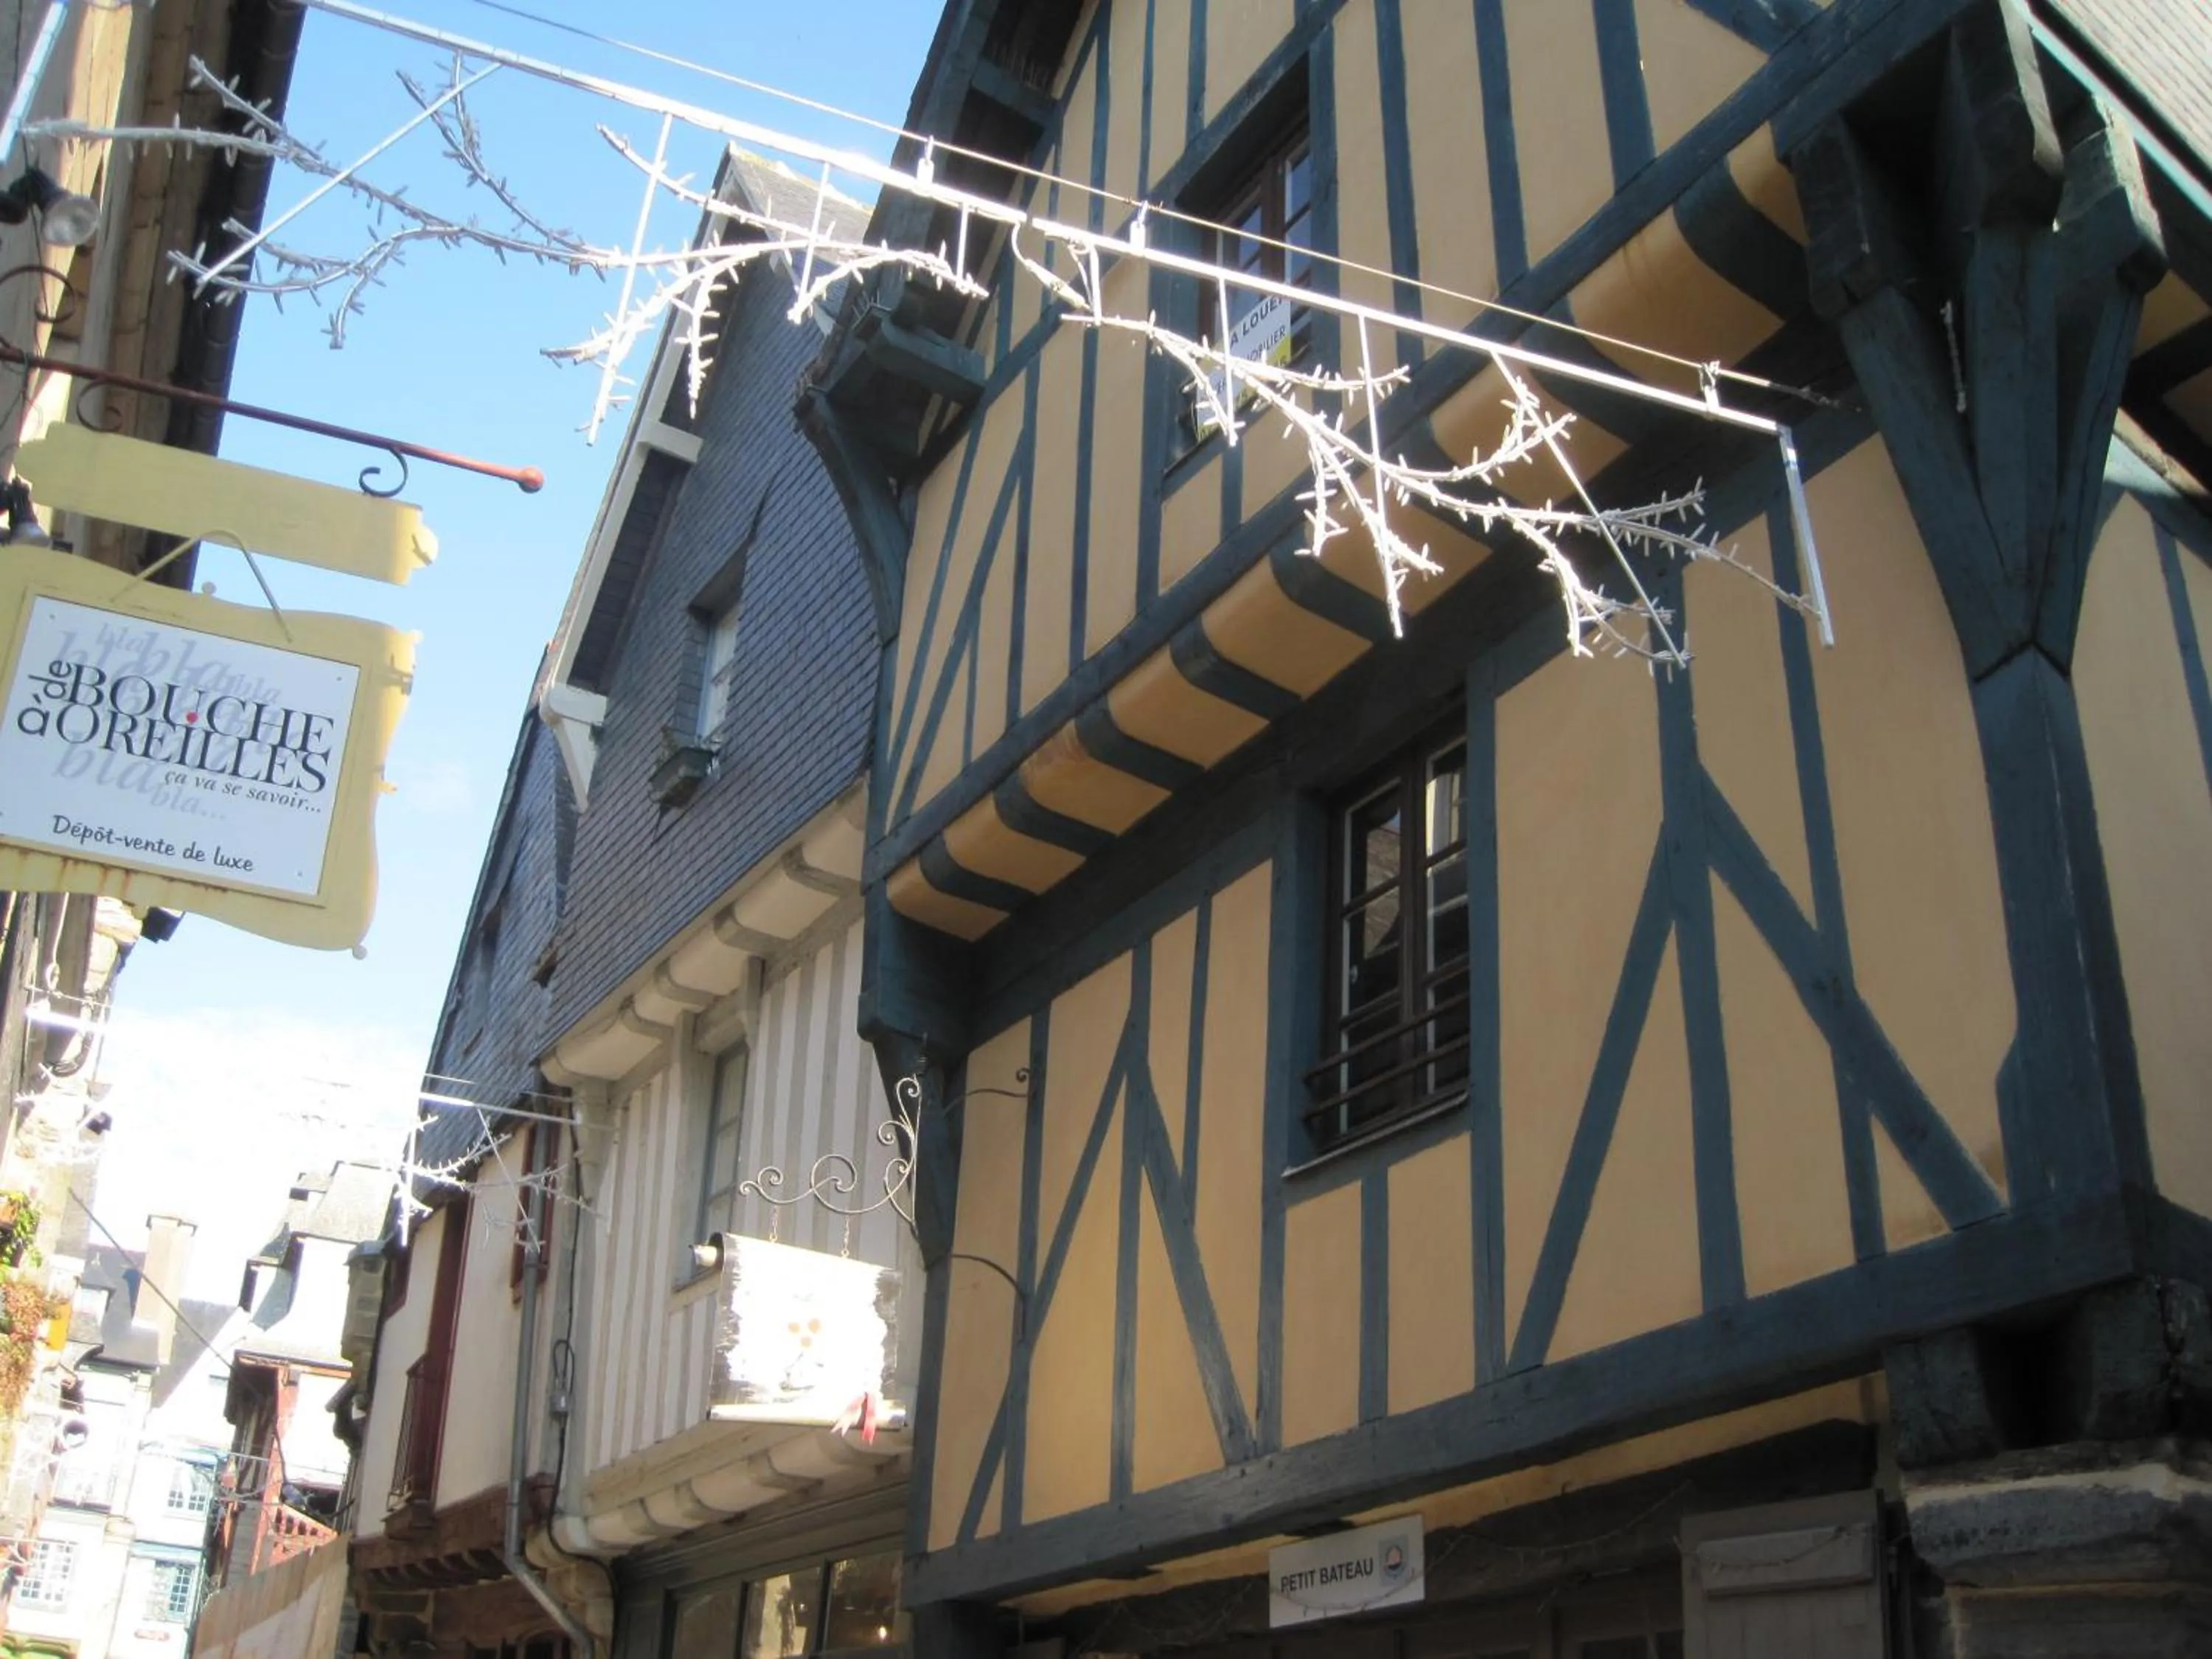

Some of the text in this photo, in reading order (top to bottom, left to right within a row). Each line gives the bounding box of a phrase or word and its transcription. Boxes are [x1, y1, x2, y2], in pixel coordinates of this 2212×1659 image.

[1230, 332, 1239, 349] A
[28, 660, 335, 755] de BOUCHE
[17, 693, 330, 793] à OREILLES
[164, 770, 321, 813] ça va se savoir...
[52, 814, 254, 872] Dépôt-vente de luxe
[1281, 1557, 1374, 1593] PETIT BATEAU
